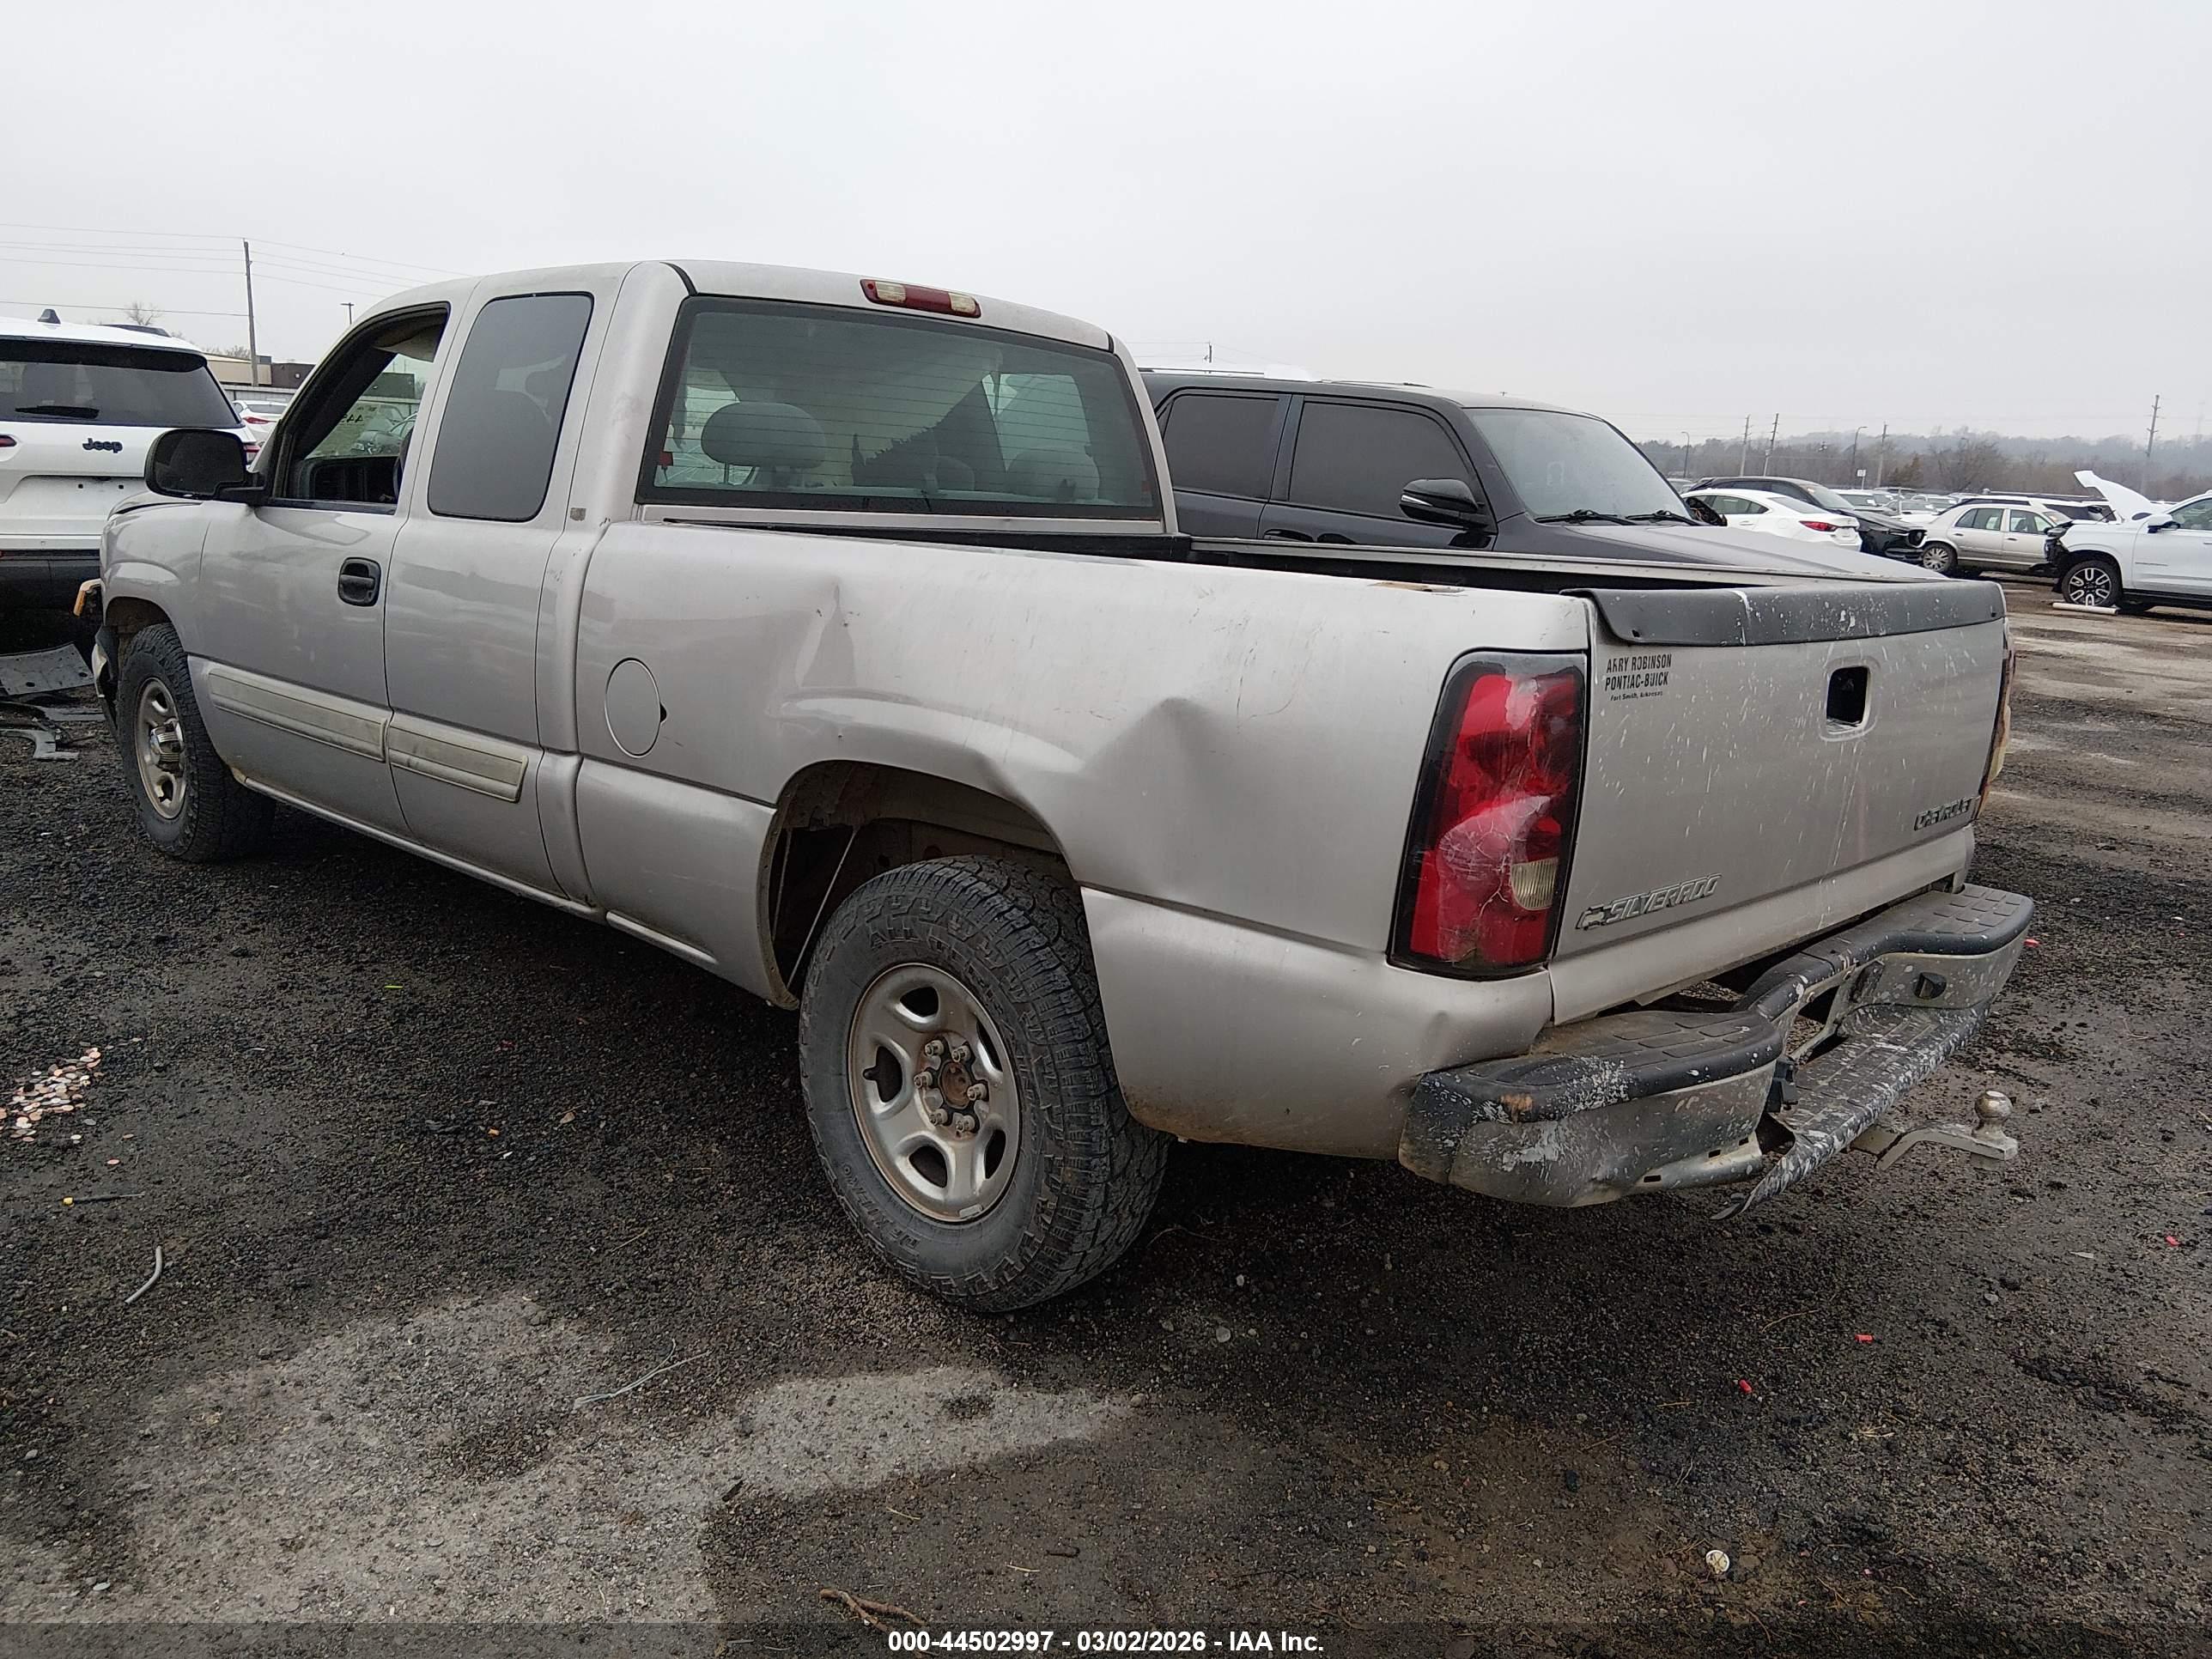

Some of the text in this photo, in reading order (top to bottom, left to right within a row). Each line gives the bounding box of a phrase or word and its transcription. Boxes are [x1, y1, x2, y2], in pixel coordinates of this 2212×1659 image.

[82, 437, 123, 453] Jeep
[1632, 653, 1672, 671] ROBINSON
[1605, 672, 1669, 691] PONTIAC-BUICK
[1606, 873, 1723, 924] SILVERADO
